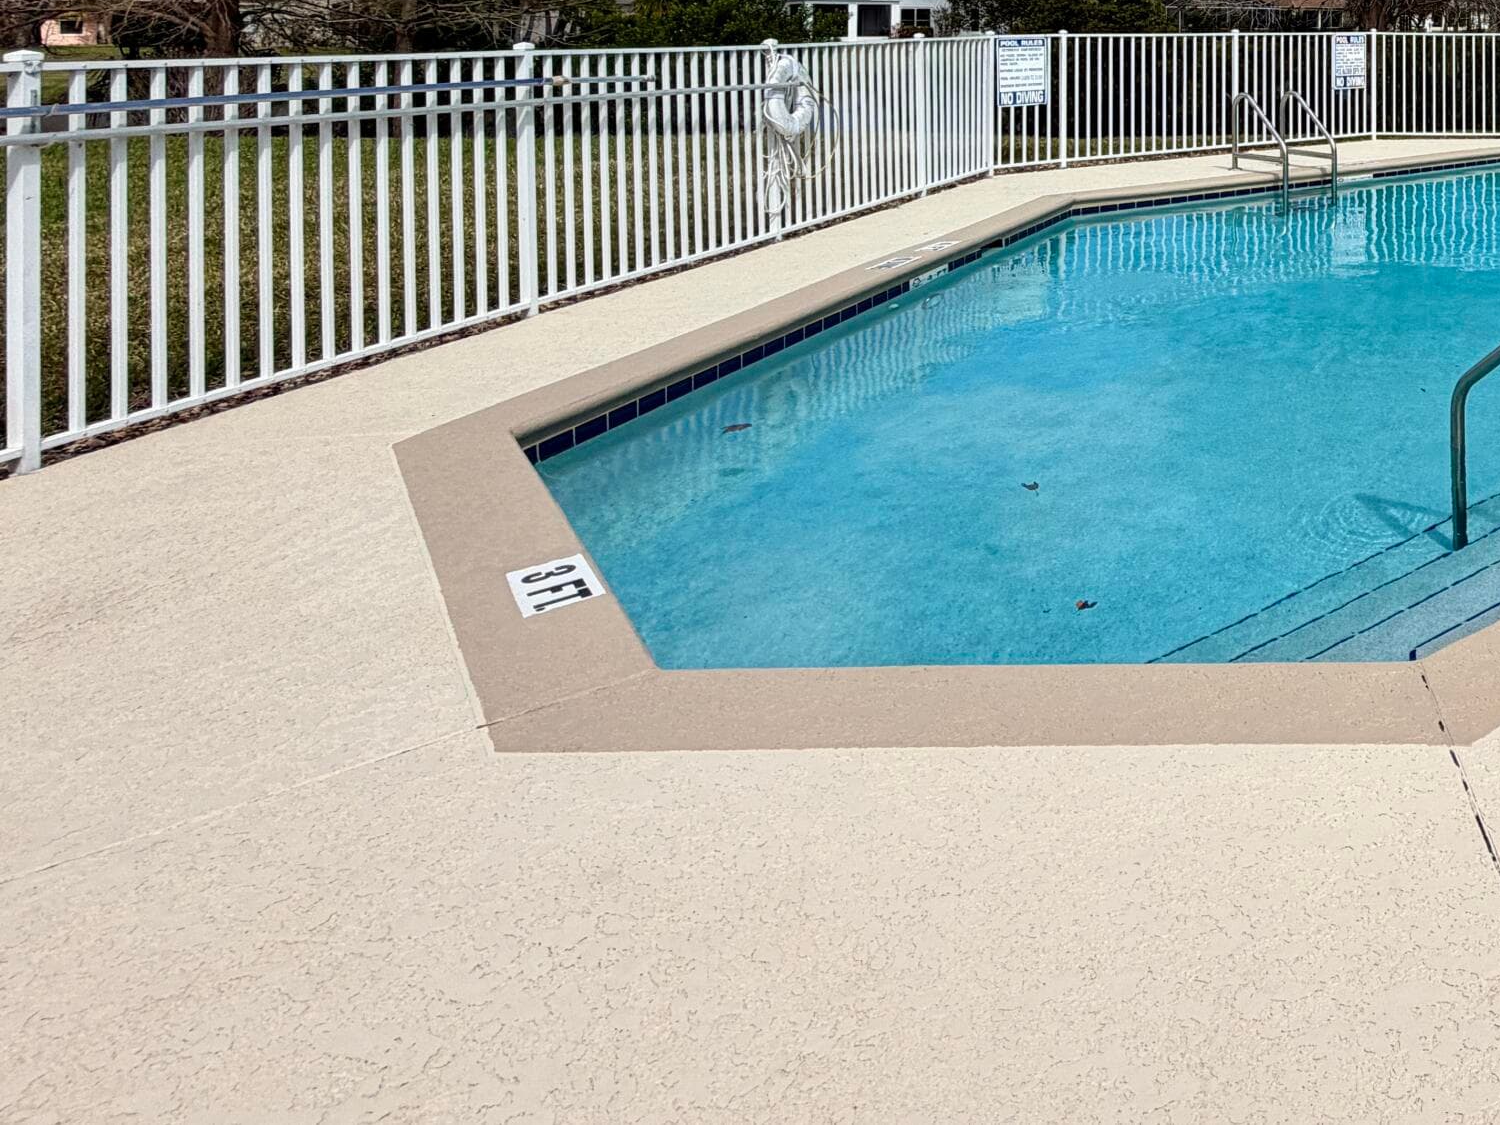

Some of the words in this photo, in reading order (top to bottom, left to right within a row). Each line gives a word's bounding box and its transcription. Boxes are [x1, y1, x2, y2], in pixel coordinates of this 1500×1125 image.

[1001, 92, 1014, 105] NO
[1016, 91, 1044, 104] DIVING
[521, 564, 577, 584] 3
